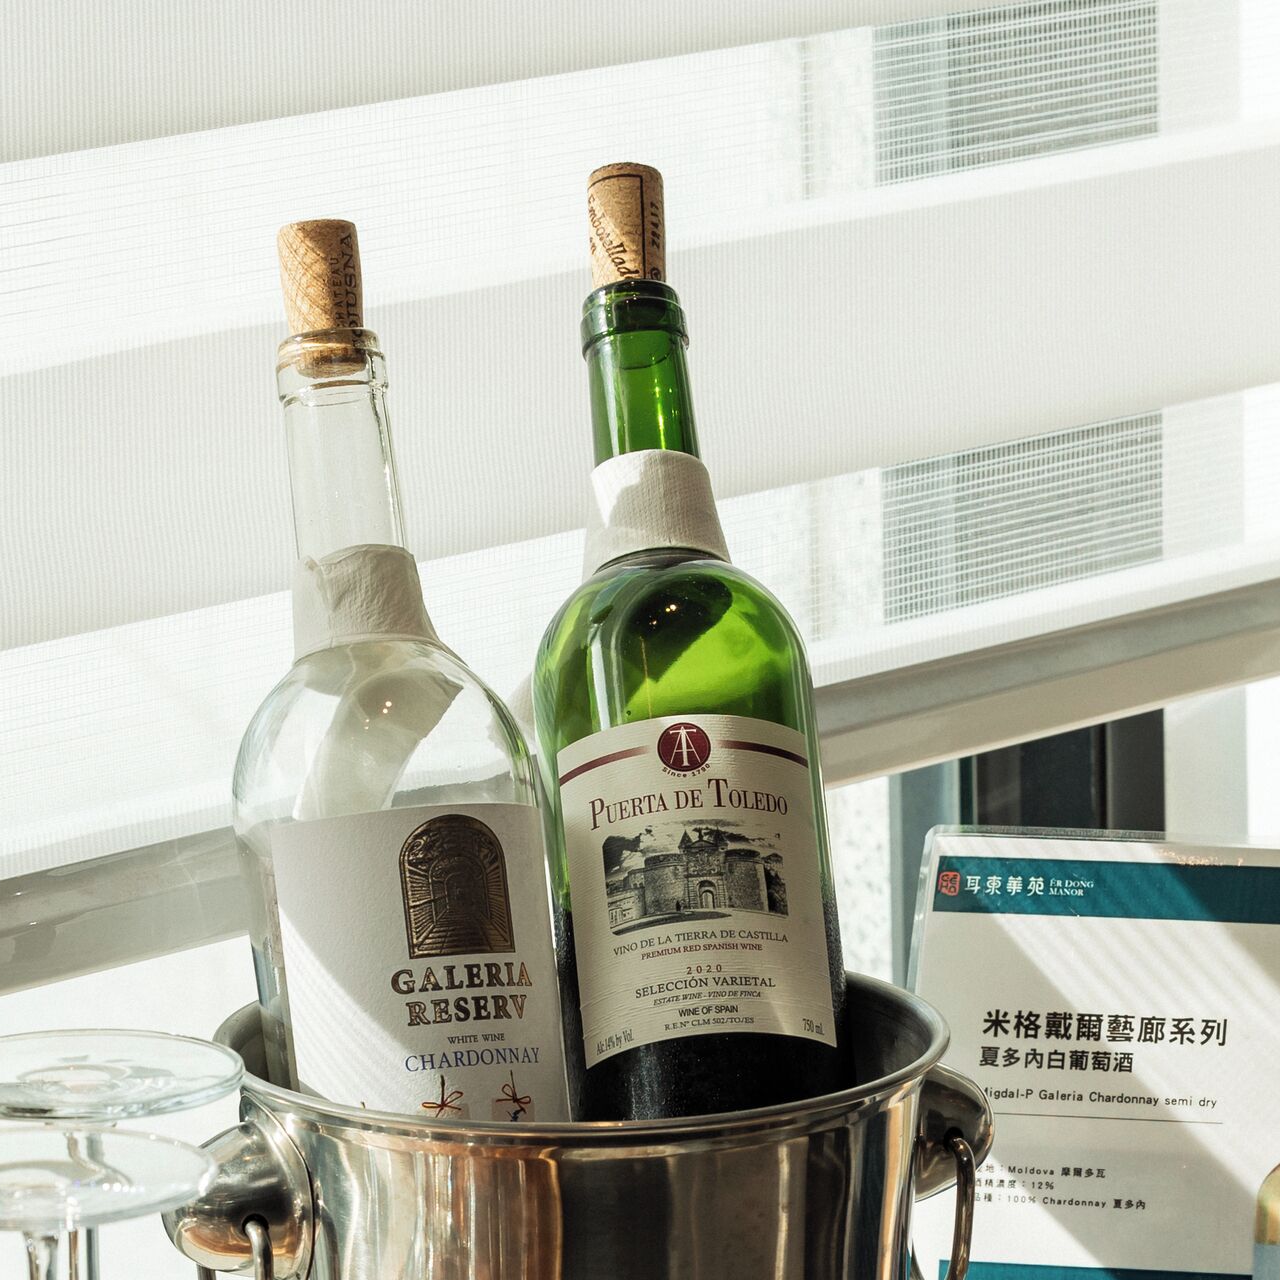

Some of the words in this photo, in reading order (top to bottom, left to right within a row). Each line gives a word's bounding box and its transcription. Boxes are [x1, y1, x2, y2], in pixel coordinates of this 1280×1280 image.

[662, 766, 687, 777] Since
[691, 763, 710, 776] 1790
[588, 794, 669, 830] PUERTA
[674, 789, 703, 810] DE
[707, 778, 788, 815] TOLEDO
[1064, 879, 1094, 888] DONG
[1049, 888, 1084, 896] MANOR
[613, 941, 638, 956] VINO
[640, 937, 655, 948] DE
[657, 935, 673, 945] LA
[675, 930, 717, 942] TIERRA
[720, 930, 736, 939] DE
[738, 930, 789, 943] CASTILLA
[641, 946, 681, 960] PREMIUM
[682, 944, 702, 954] RED
[703, 943, 738, 952] SPANISH
[740, 943, 763, 951] WINE
[686, 964, 722, 975] 2020
[391, 961, 532, 994] GALERIA
[635, 976, 709, 999] SELECCIÓN
[712, 976, 776, 988] VARIETAL
[653, 994, 680, 1005] ESTATE
[681, 992, 703, 1001] WINE
[735, 990, 761, 998] FINCA
[406, 994, 527, 1026] RESERV
[678, 1007, 700, 1017] WINE
[701, 1006, 714, 1015] OF
[715, 1004, 738, 1014] SPAIN
[691, 1019, 710, 1027] CLM
[803, 1018, 814, 1032] 750
[983, 1009, 1228, 1047] 米格戴爾藝廊系列
[448, 1034, 478, 1045] WHITE
[482, 1033, 505, 1042] WINE
[405, 1047, 540, 1072] CHARDONNAY
[979, 1046, 1134, 1073] 夏多內白葡萄酒
[1039, 1089, 1083, 1102] Galeria
[1089, 1092, 1159, 1106] Chardonnay
[1164, 1096, 1193, 1107] semi
[1198, 1098, 1217, 1109] dry
[1061, 1167, 1106, 1178] 摩爾多瓦
[1042, 1197, 1106, 1208] Chardonnay
[1113, 1199, 1146, 1210] 夏多內
